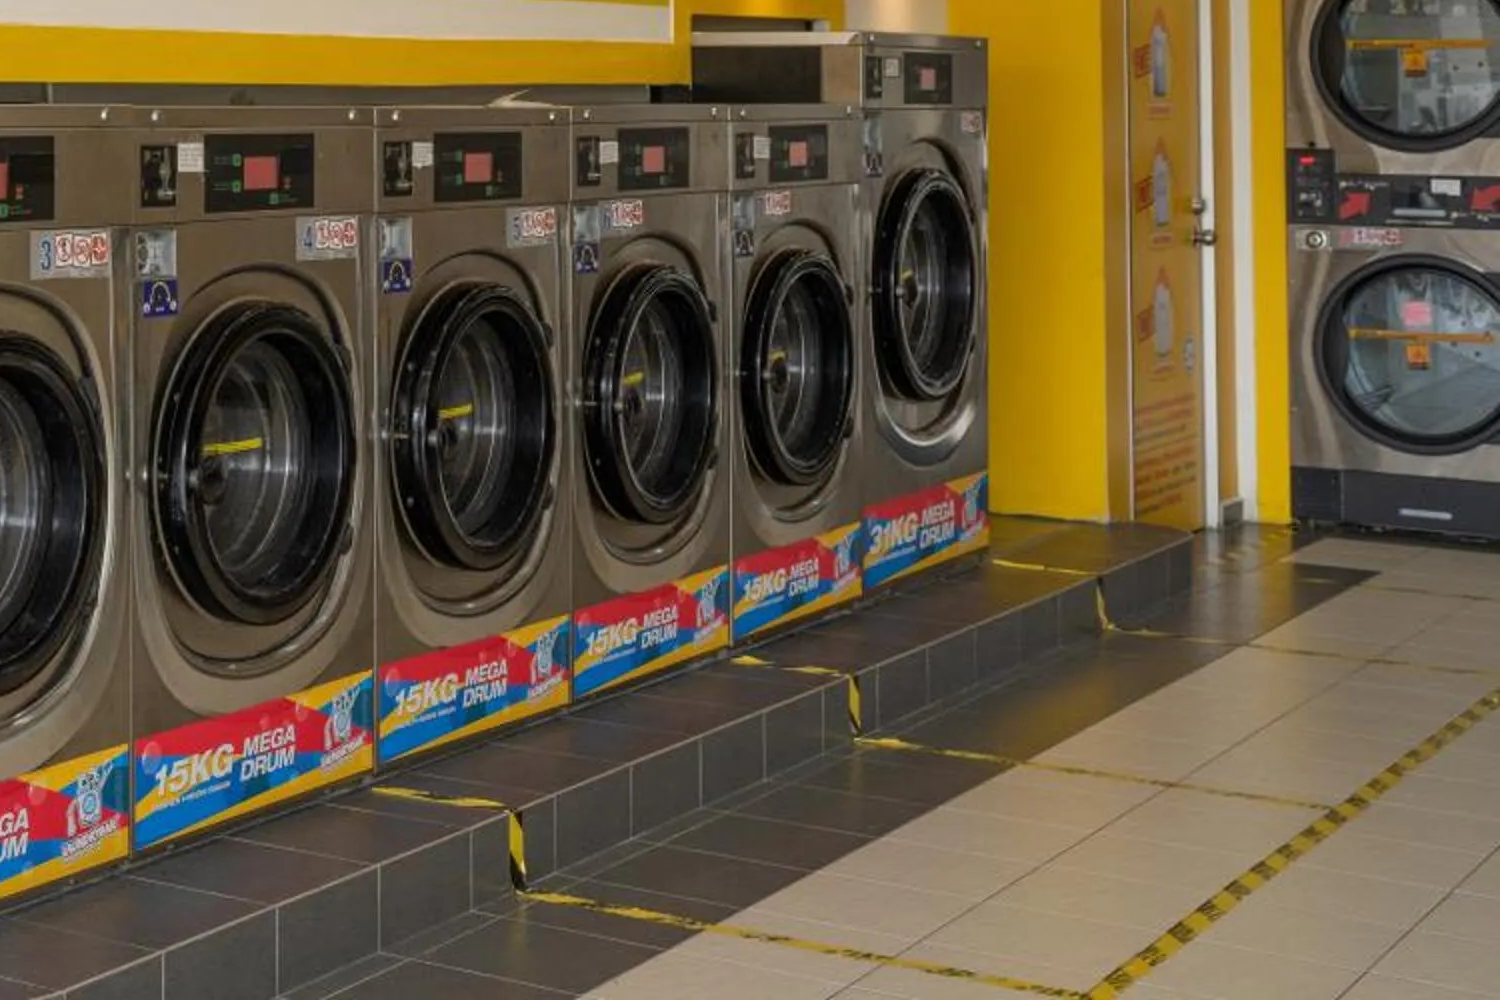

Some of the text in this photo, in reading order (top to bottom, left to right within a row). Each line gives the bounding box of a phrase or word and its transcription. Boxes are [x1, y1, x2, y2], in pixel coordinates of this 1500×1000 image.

[40, 237, 51, 271] 3
[920, 499, 955, 528] MEGA
[919, 521, 955, 549] DRUM
[744, 556, 819, 600] 15KG MEGA
[788, 576, 819, 597] DRUM
[586, 603, 679, 656] 15KG MEGA
[640, 620, 677, 648] DRUM
[395, 657, 508, 716] 15KG MEGA
[462, 677, 508, 708] DRUM
[155, 724, 296, 797] 15KG MEGA
[240, 746, 296, 782] DRUM
